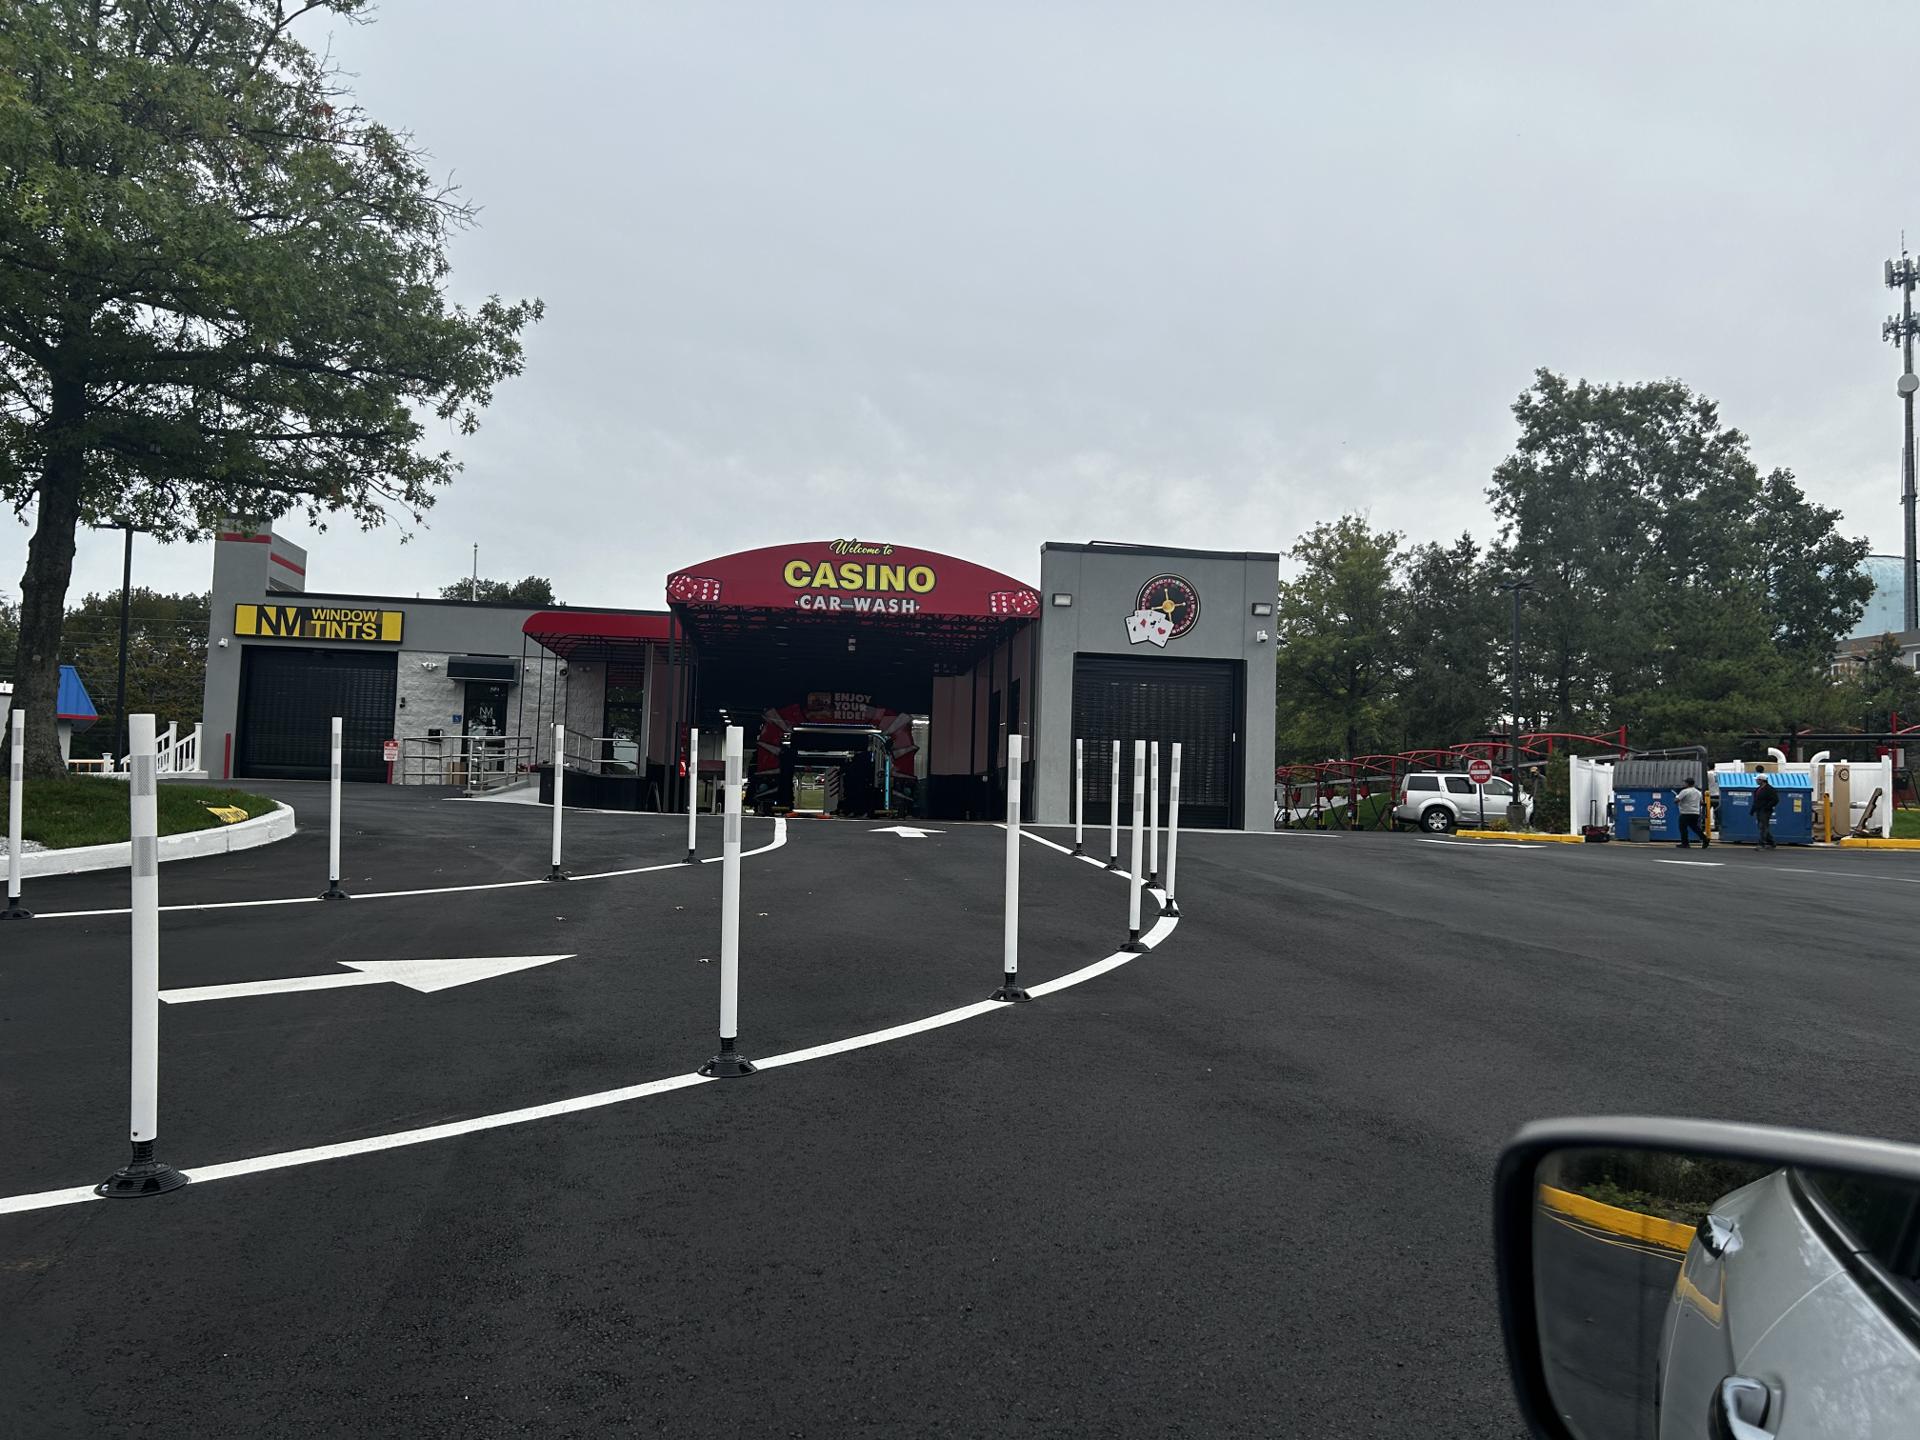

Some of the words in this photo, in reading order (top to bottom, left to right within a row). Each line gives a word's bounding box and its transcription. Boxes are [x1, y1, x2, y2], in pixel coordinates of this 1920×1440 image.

[829, 538, 880, 555] Welcome
[883, 544, 893, 555] to
[784, 560, 936, 593] CASINO
[800, 595, 841, 611] CAR
[854, 597, 915, 614] WASH
[257, 606, 304, 636] NM
[311, 608, 377, 622] WINDOW
[311, 621, 377, 640] TINTS
[834, 692, 872, 704] ENJOY
[834, 702, 867, 712] YOUR
